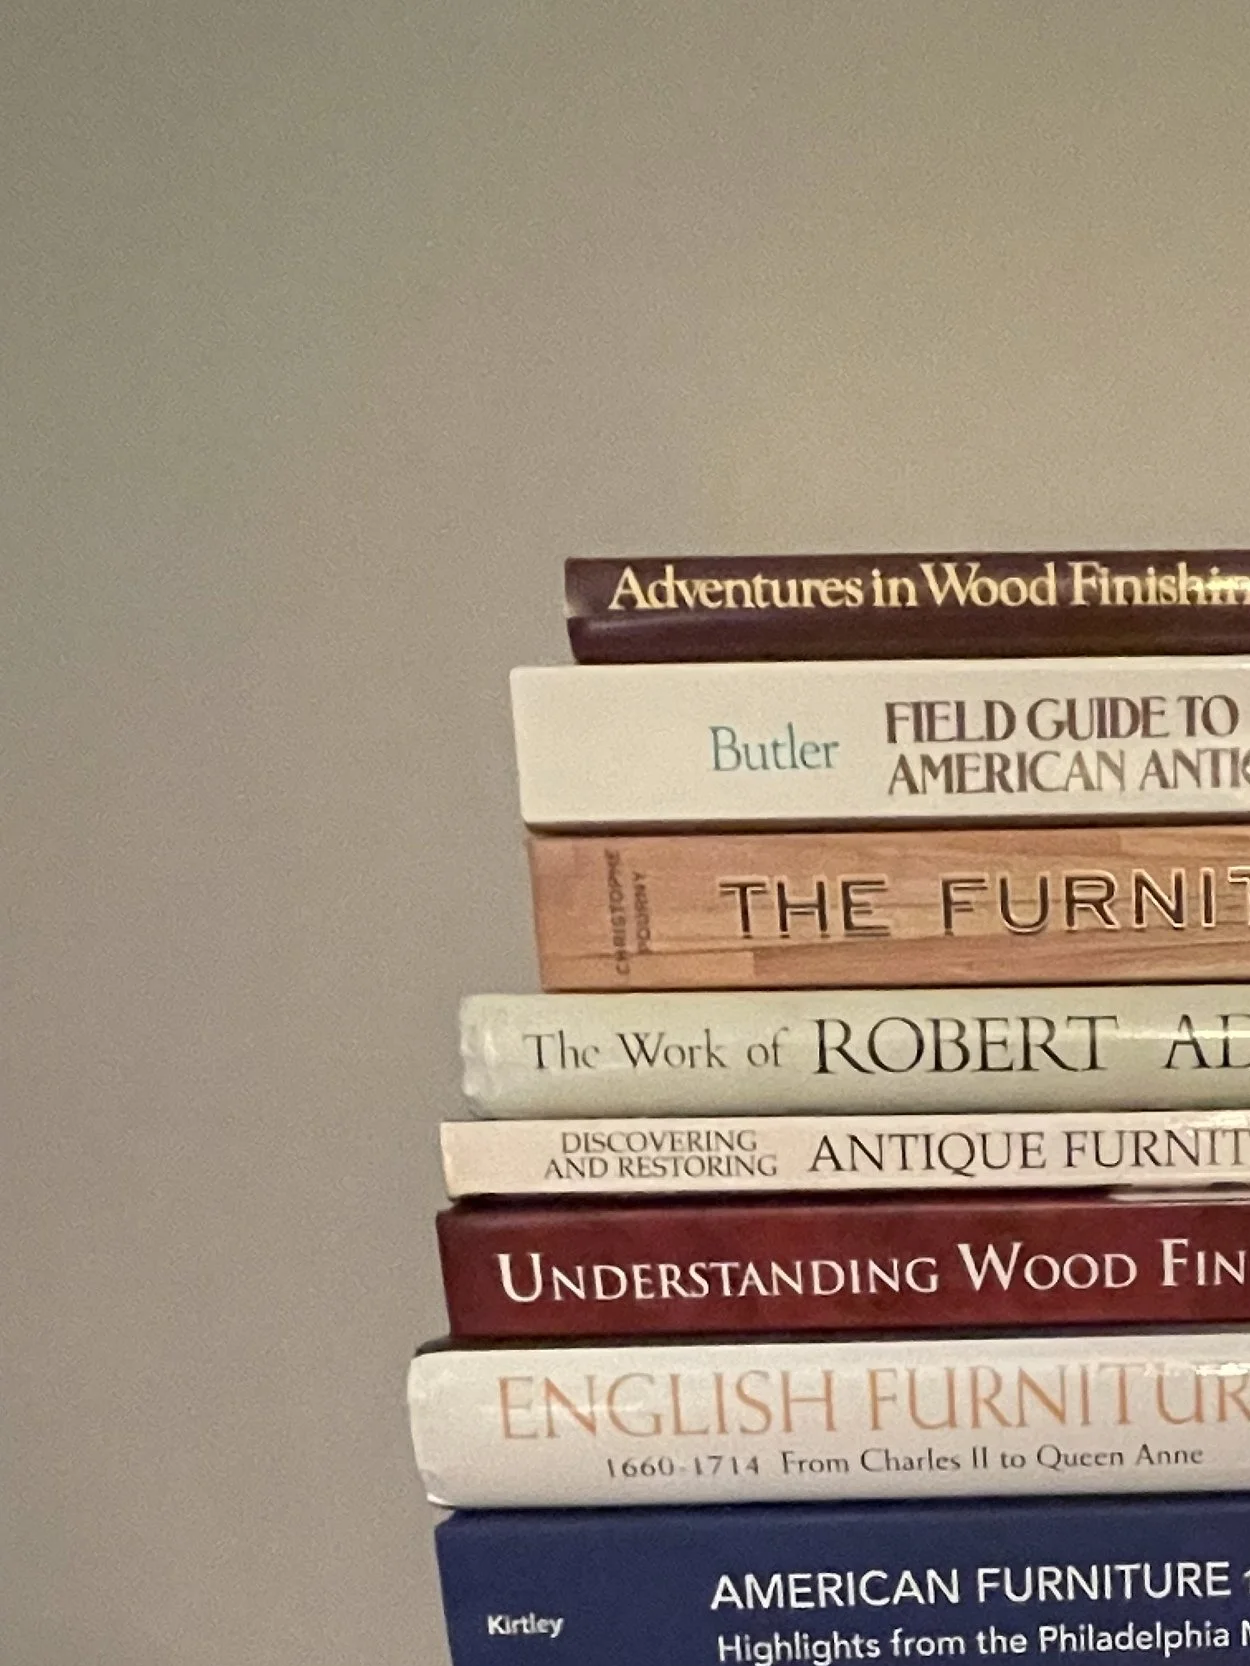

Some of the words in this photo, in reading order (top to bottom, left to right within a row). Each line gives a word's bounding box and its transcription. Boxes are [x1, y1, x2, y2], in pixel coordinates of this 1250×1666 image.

[609, 565, 863, 611] Adventures
[873, 565, 916, 608] in
[919, 561, 1057, 608] Wood
[885, 698, 1017, 743] FIELD
[1027, 695, 1168, 741] GUIDE
[1176, 695, 1239, 738] TO
[709, 723, 839, 771] Butler
[888, 748, 1124, 795] AMERICAN
[719, 873, 891, 940] THE
[523, 1032, 600, 1069] The
[616, 1030, 728, 1070] Work
[746, 1027, 789, 1068] of
[812, 1014, 1119, 1074] ROBERT
[561, 1129, 757, 1154] DISCOVERING
[807, 1130, 1047, 1177] ANTIQUE
[543, 1156, 608, 1180] AND
[617, 1153, 779, 1179] RESTORING
[498, 1368, 838, 1440] ENGLISH
[781, 1449, 852, 1476] From
[860, 1446, 964, 1473] Charles
[970, 1446, 990, 1469] II
[999, 1448, 1028, 1470] to
[1036, 1441, 1126, 1472] Queen
[1134, 1442, 1206, 1467] Anne
[711, 1567, 961, 1611] AMERICAN
[977, 1560, 1231, 1602] FURNITURE
[486, 1614, 565, 1640] Kirtley
[890, 1627, 965, 1658] from
[976, 1628, 1028, 1655] the
[1038, 1620, 1232, 1660] Philadelphia
